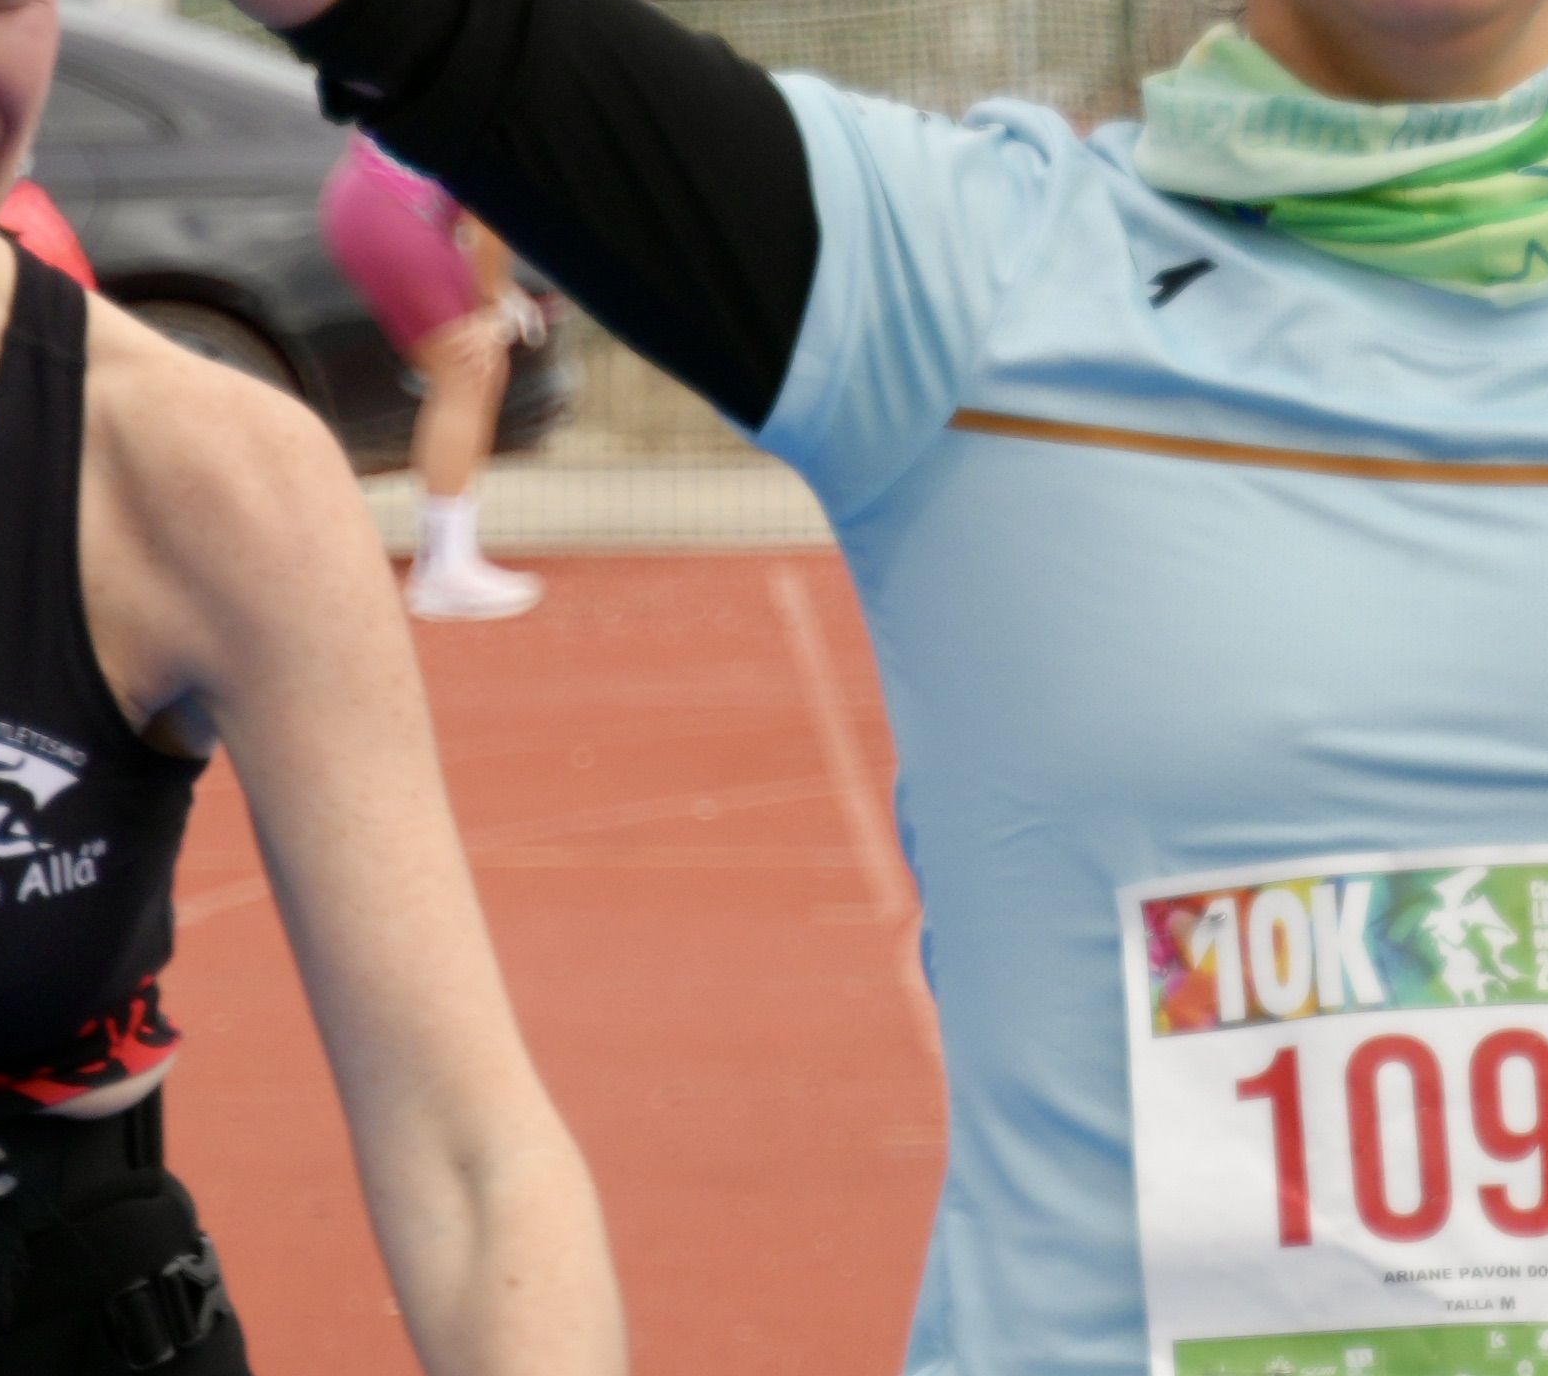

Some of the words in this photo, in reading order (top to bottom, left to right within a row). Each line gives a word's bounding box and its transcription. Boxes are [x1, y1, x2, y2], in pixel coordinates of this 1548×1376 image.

[1192, 879, 1387, 1023] 10K
[1383, 1267, 1453, 1285] ARIANE
[1443, 1298, 1494, 1312] TALLA
[1500, 1295, 1516, 1311] M
